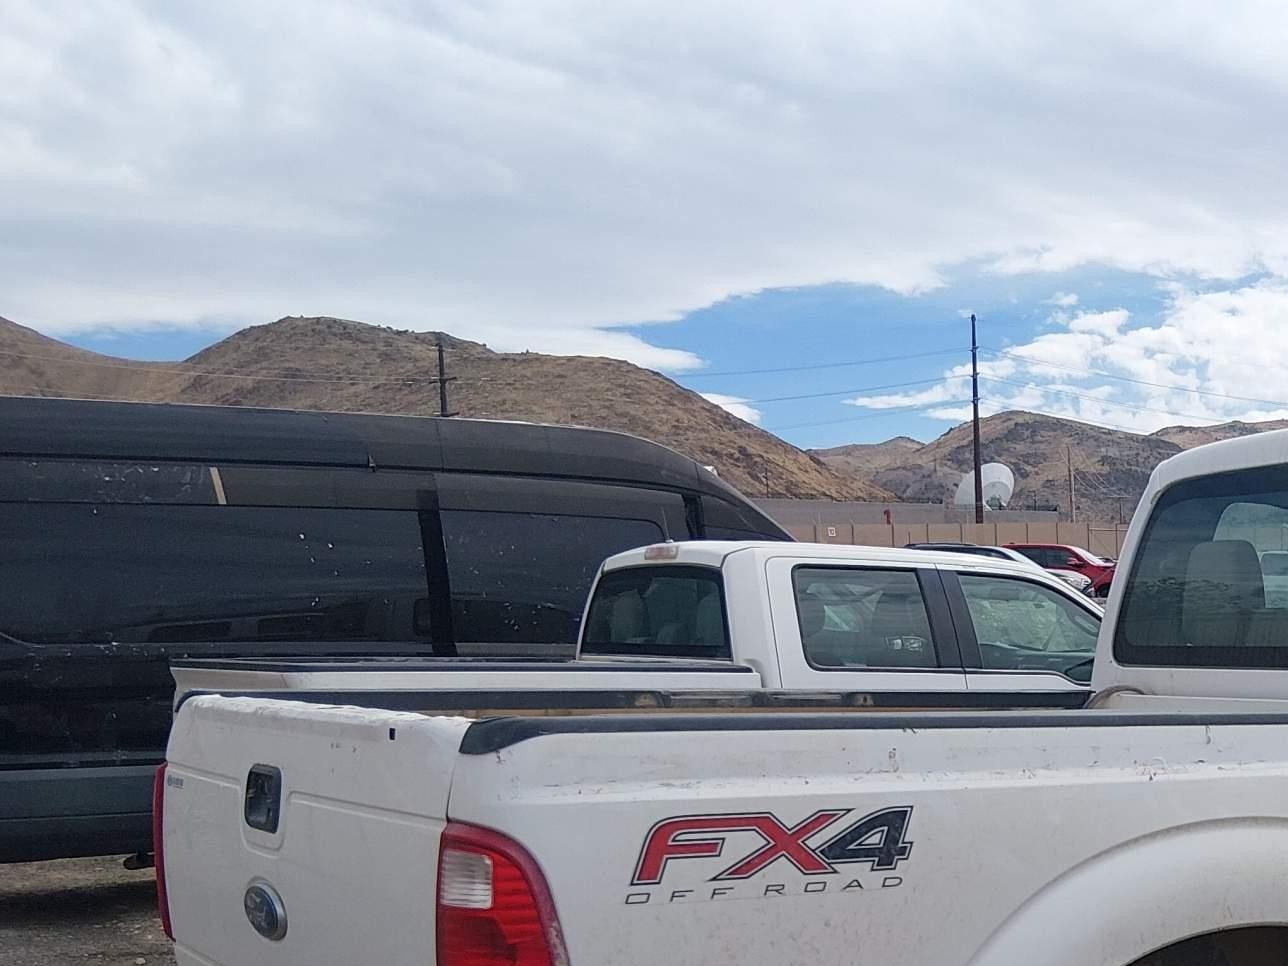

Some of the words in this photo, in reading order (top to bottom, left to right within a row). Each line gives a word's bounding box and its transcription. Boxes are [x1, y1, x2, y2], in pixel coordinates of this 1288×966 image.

[630, 805, 914, 886] FX4
[624, 886, 735, 905] OFF
[763, 875, 904, 897] ROAD
